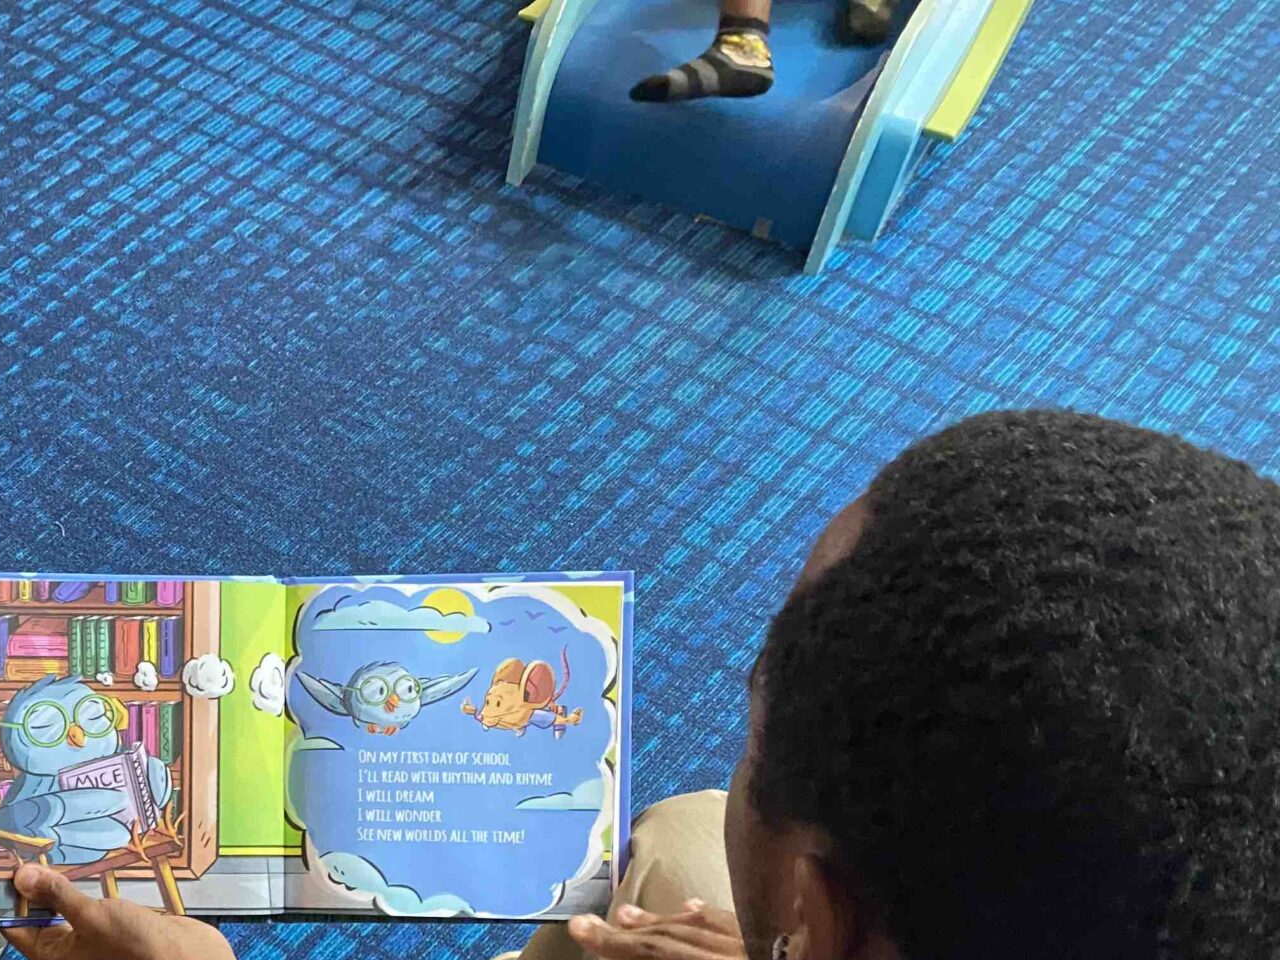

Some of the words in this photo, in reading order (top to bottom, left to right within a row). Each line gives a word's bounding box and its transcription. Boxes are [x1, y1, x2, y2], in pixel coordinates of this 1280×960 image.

[358, 749, 377, 764] ON
[379, 751, 398, 764] MY
[400, 751, 430, 764] FIRST
[431, 752, 453, 764] DAY
[455, 752, 470, 765] OF
[471, 752, 512, 766] SCHOOL
[76, 767, 123, 788] MICE
[358, 769, 379, 783] I'LL
[381, 770, 408, 783] READ
[410, 771, 440, 784] WITH
[442, 772, 487, 785] RHYTHM
[488, 773, 513, 785] AND
[515, 773, 553, 786] RHYME
[358, 788, 363, 802] I
[365, 790, 392, 803] WILL
[395, 790, 435, 803] DREAM
[357, 808, 363, 821] I
[365, 809, 392, 822] WILL
[395, 810, 442, 822] WONDER
[356, 827, 374, 841] SEE
[376, 829, 403, 842] NEW
[404, 829, 448, 842] WORLDS
[449, 830, 468, 843] ALL
[470, 830, 489, 843] THE
[491, 830, 526, 844] TIME!
